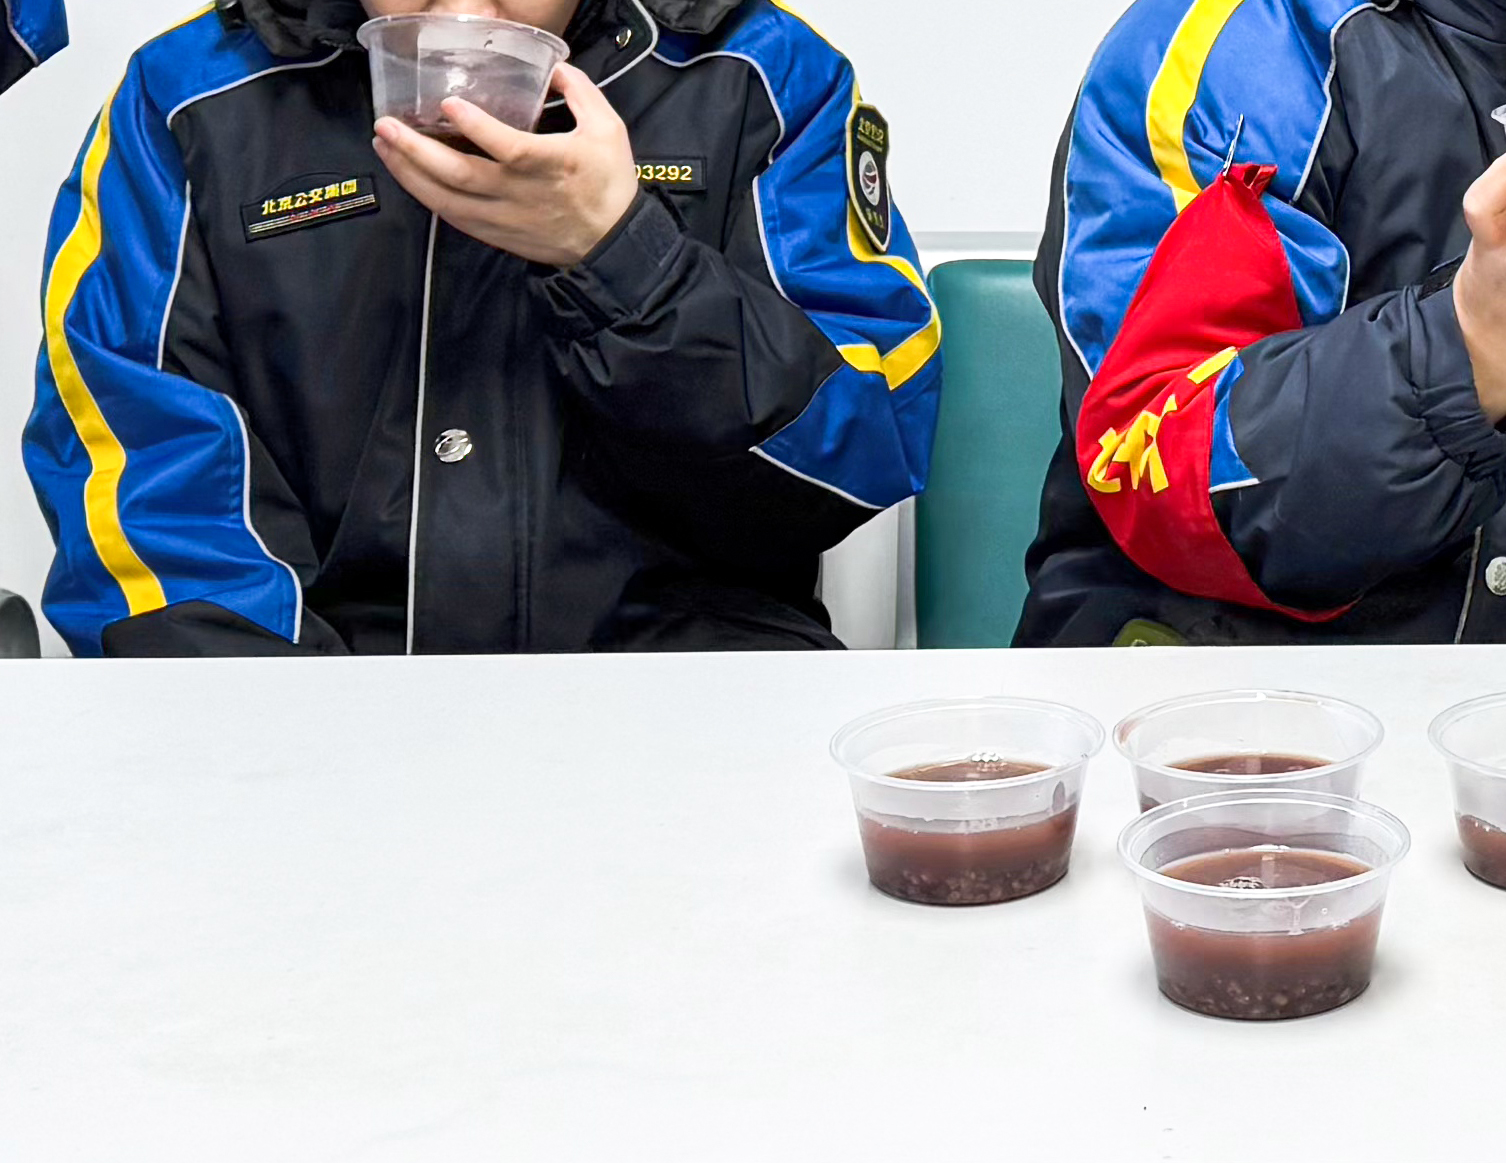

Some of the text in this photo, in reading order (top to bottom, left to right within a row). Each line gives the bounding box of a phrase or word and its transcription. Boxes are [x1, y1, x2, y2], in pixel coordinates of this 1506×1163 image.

[261, 178, 357, 216] 北京公交集团
